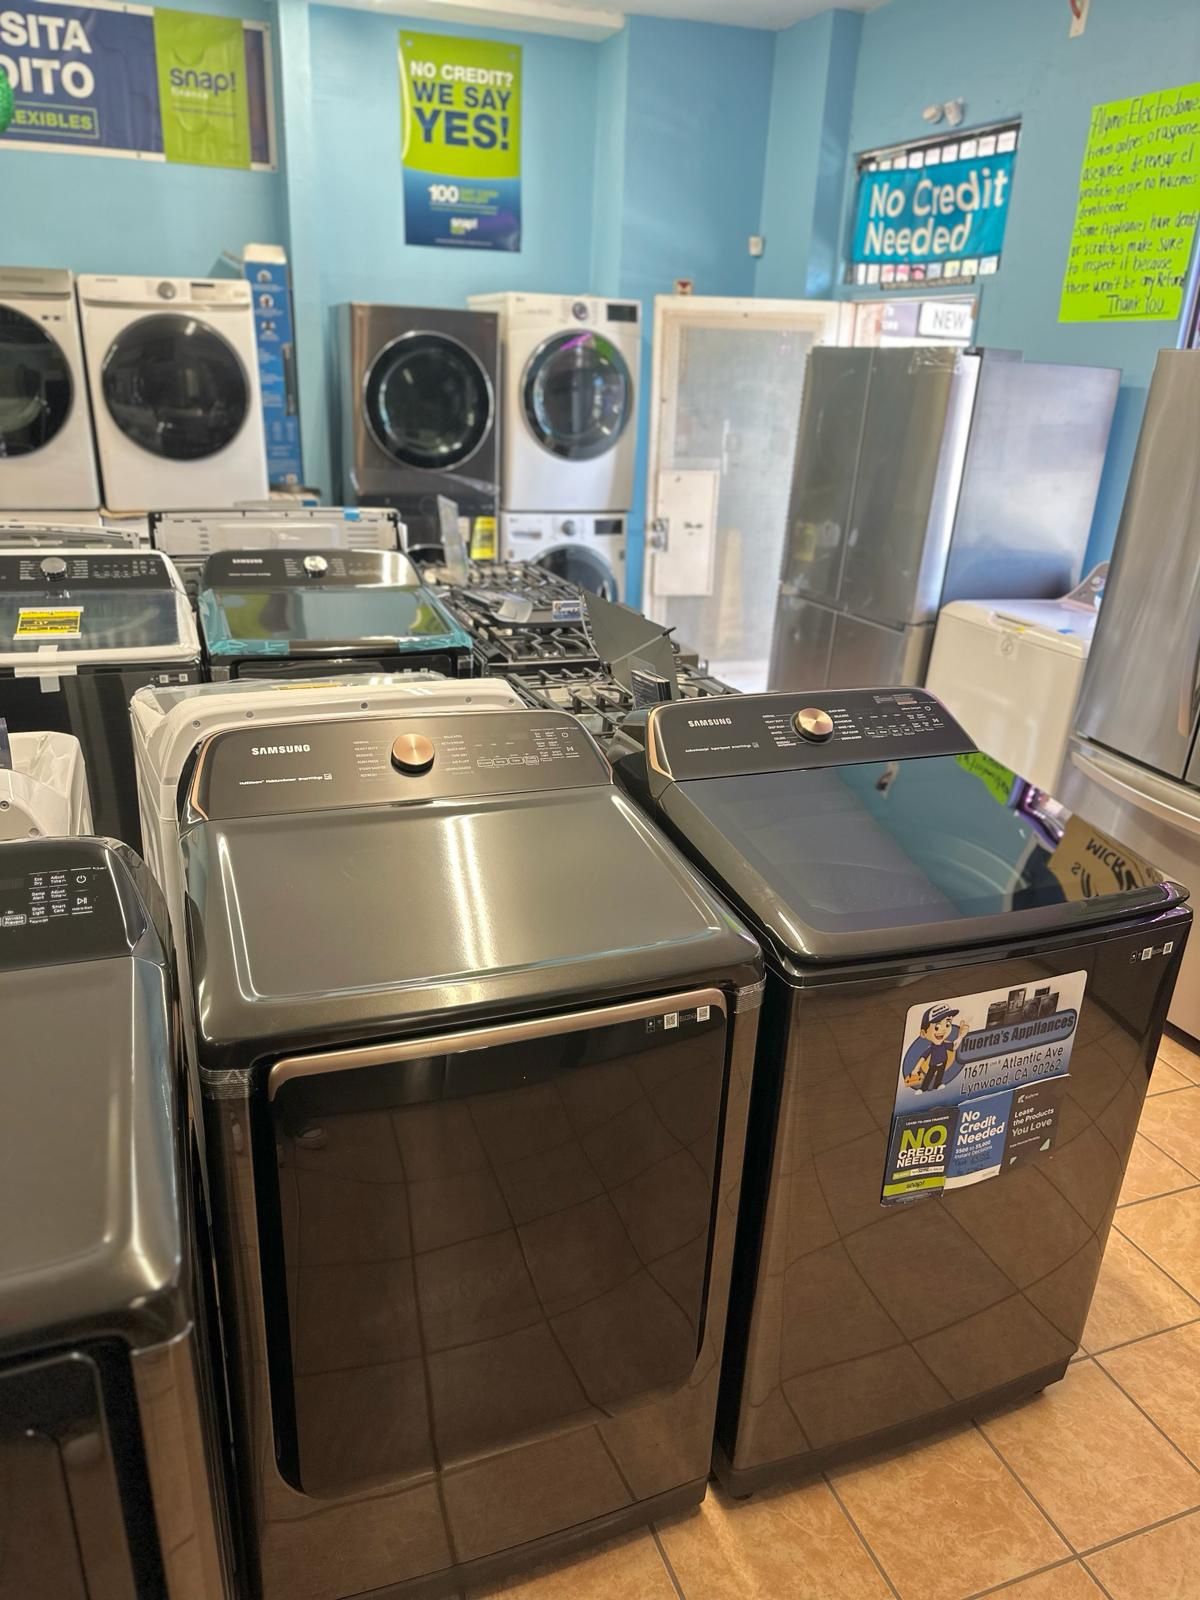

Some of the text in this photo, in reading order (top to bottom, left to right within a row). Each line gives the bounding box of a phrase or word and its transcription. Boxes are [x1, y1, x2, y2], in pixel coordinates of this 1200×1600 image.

[0, 11, 92, 54] SITA
[170, 68, 236, 96] snap!
[410, 60, 514, 87] NO CREDIT?
[412, 80, 512, 112] WE SAY
[13, 108, 93, 130] EXIBLES
[414, 106, 510, 151] YES!
[1181, 142, 1194, 163] el
[428, 184, 460, 204] 100
[869, 167, 1008, 220] No Credit
[1150, 212, 1171, 230] have
[863, 213, 972, 258] Needed
[1126, 238, 1153, 252] make
[1132, 254, 1173, 272] because
[1106, 294, 1140, 314] Thank
[932, 309, 968, 330] NEW
[687, 717, 732, 728] SAMSUNG
[251, 743, 311, 756] SAMSUNG
[960, 1015, 1075, 1053] Huerta's Appliances
[963, 1046, 1064, 1080] 11671 Atlantic Ave
[1014, 1067, 1028, 1080] CA
[1032, 1059, 1062, 1076] 90262
[961, 1110, 981, 1123] No
[1014, 1107, 1035, 1118] Lease
[1025, 1108, 1055, 1122] Products
[957, 1121, 1006, 1146] Needed
[959, 1115, 997, 1135] Credit
[1012, 1118, 1053, 1137] You Love
[900, 1124, 948, 1151] NO
[896, 1154, 945, 1169] NEEDED
[898, 1144, 947, 1160] CREDIT
